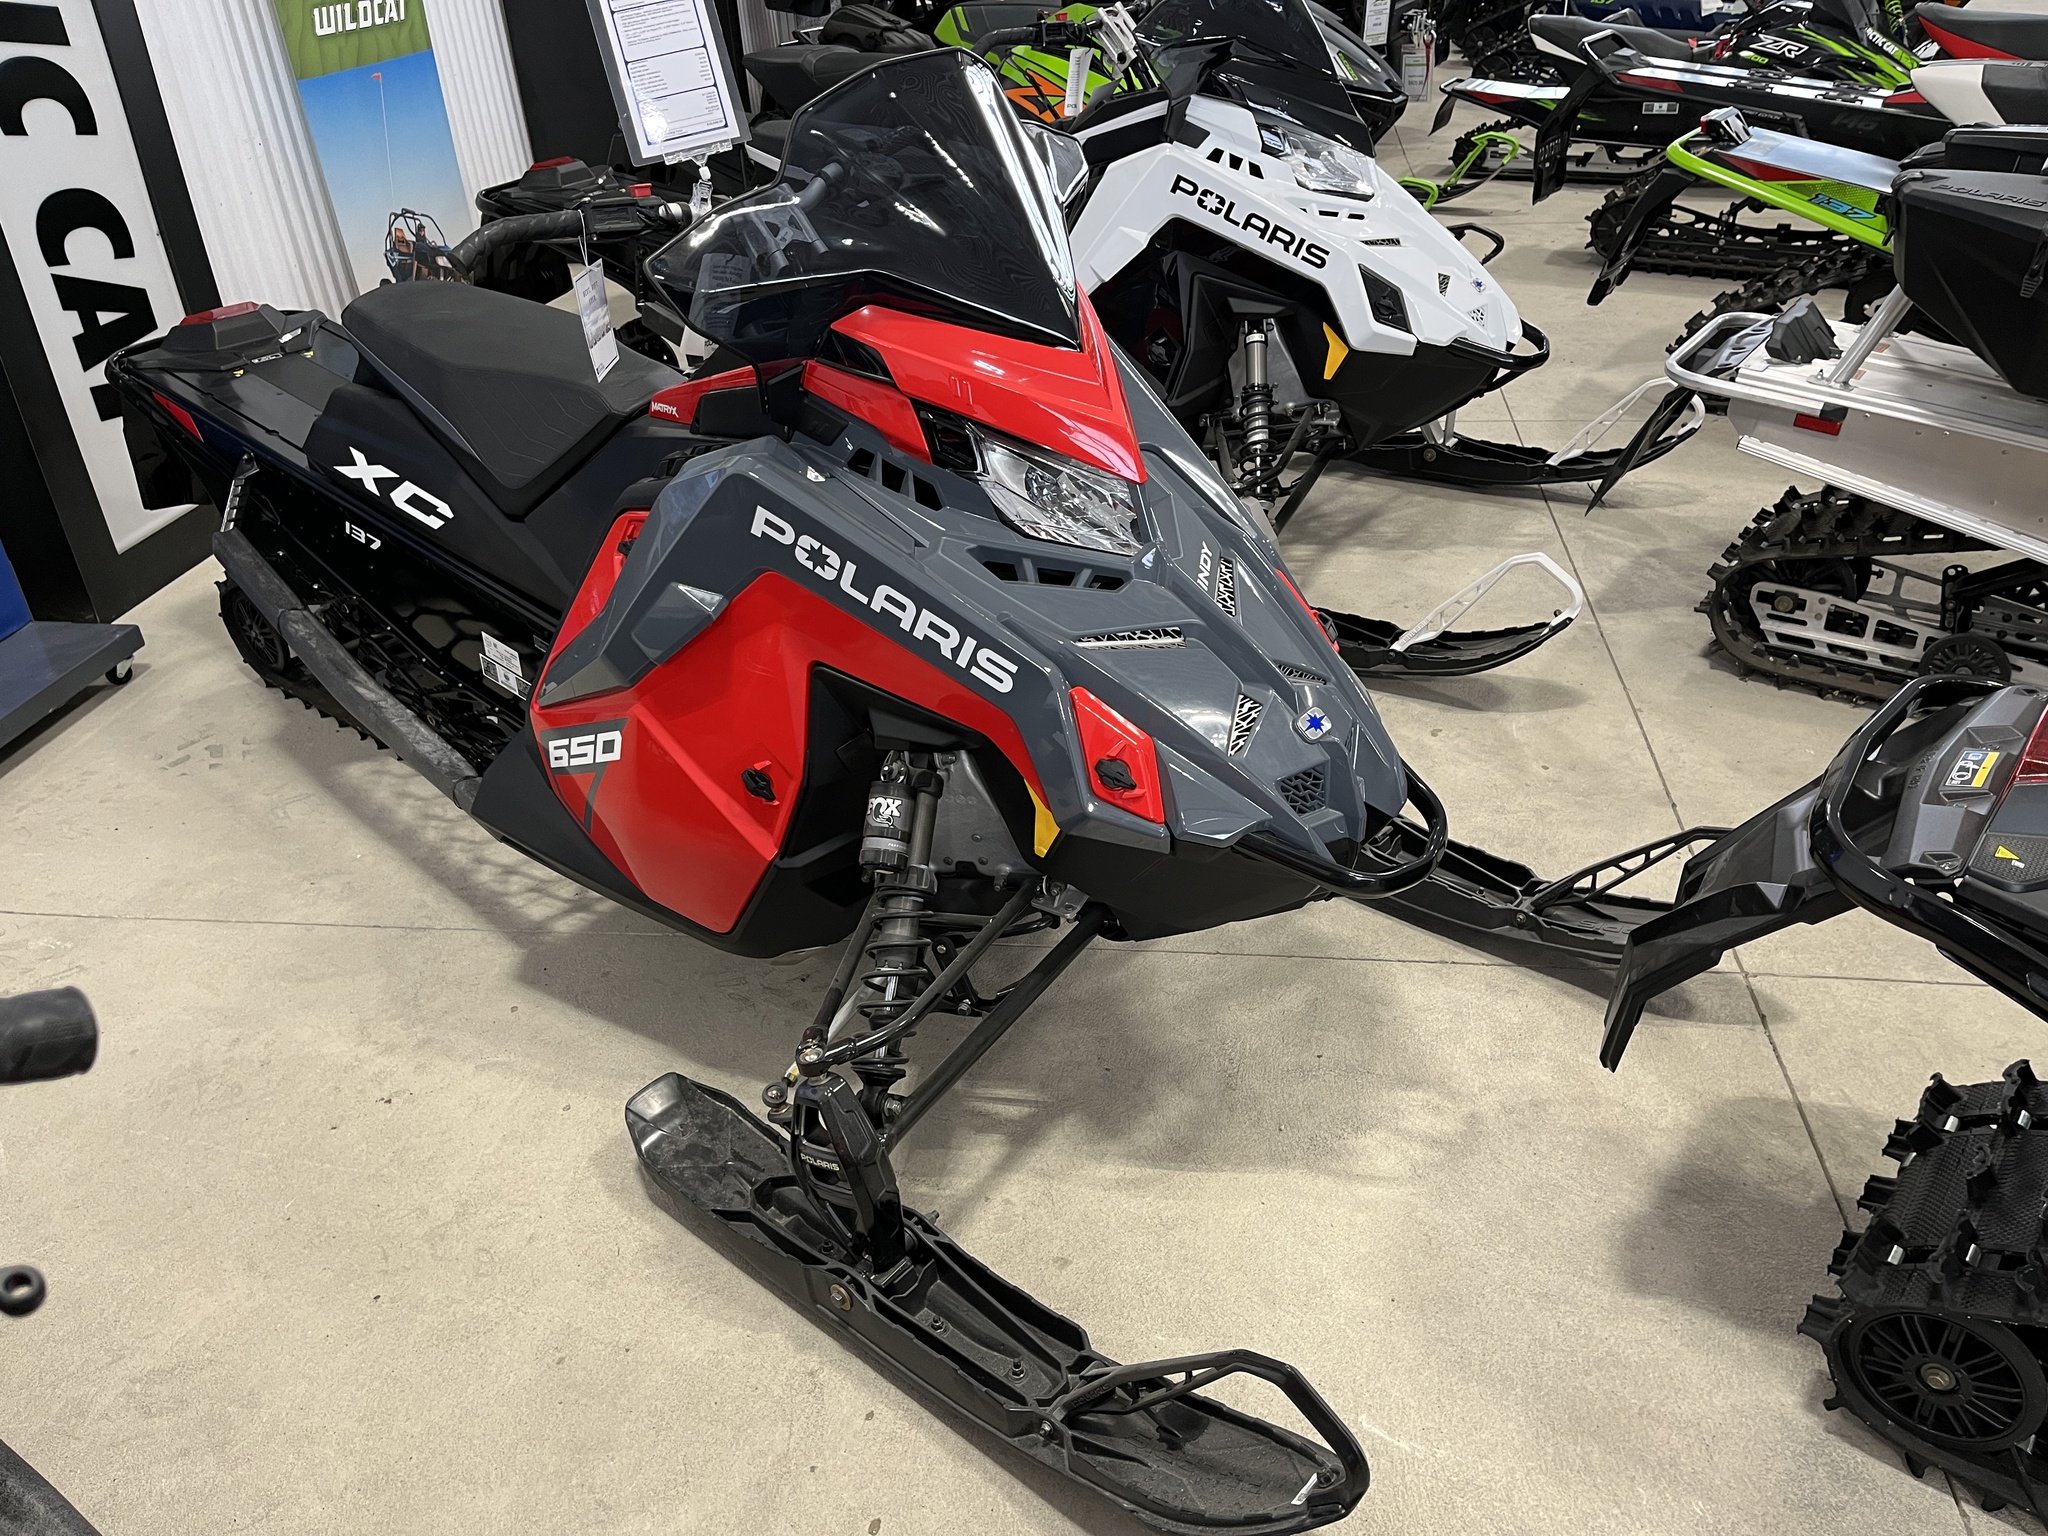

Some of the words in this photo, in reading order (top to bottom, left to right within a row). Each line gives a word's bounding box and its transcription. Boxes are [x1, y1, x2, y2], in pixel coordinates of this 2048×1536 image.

[313, 0, 405, 36] WILDCAT
[1749, 33, 1809, 59] ZR
[1809, 193, 1876, 219] 137
[1930, 184, 2048, 208] POLARIS
[1169, 174, 1331, 269] POLARIS
[651, 401, 679, 418] MATRYX
[333, 446, 455, 530] XC
[345, 520, 382, 550] 137
[1196, 541, 1213, 591] INDY
[750, 505, 1019, 694] POLARIS
[548, 730, 623, 769] 650
[800, 1152, 840, 1171] POLARIS
